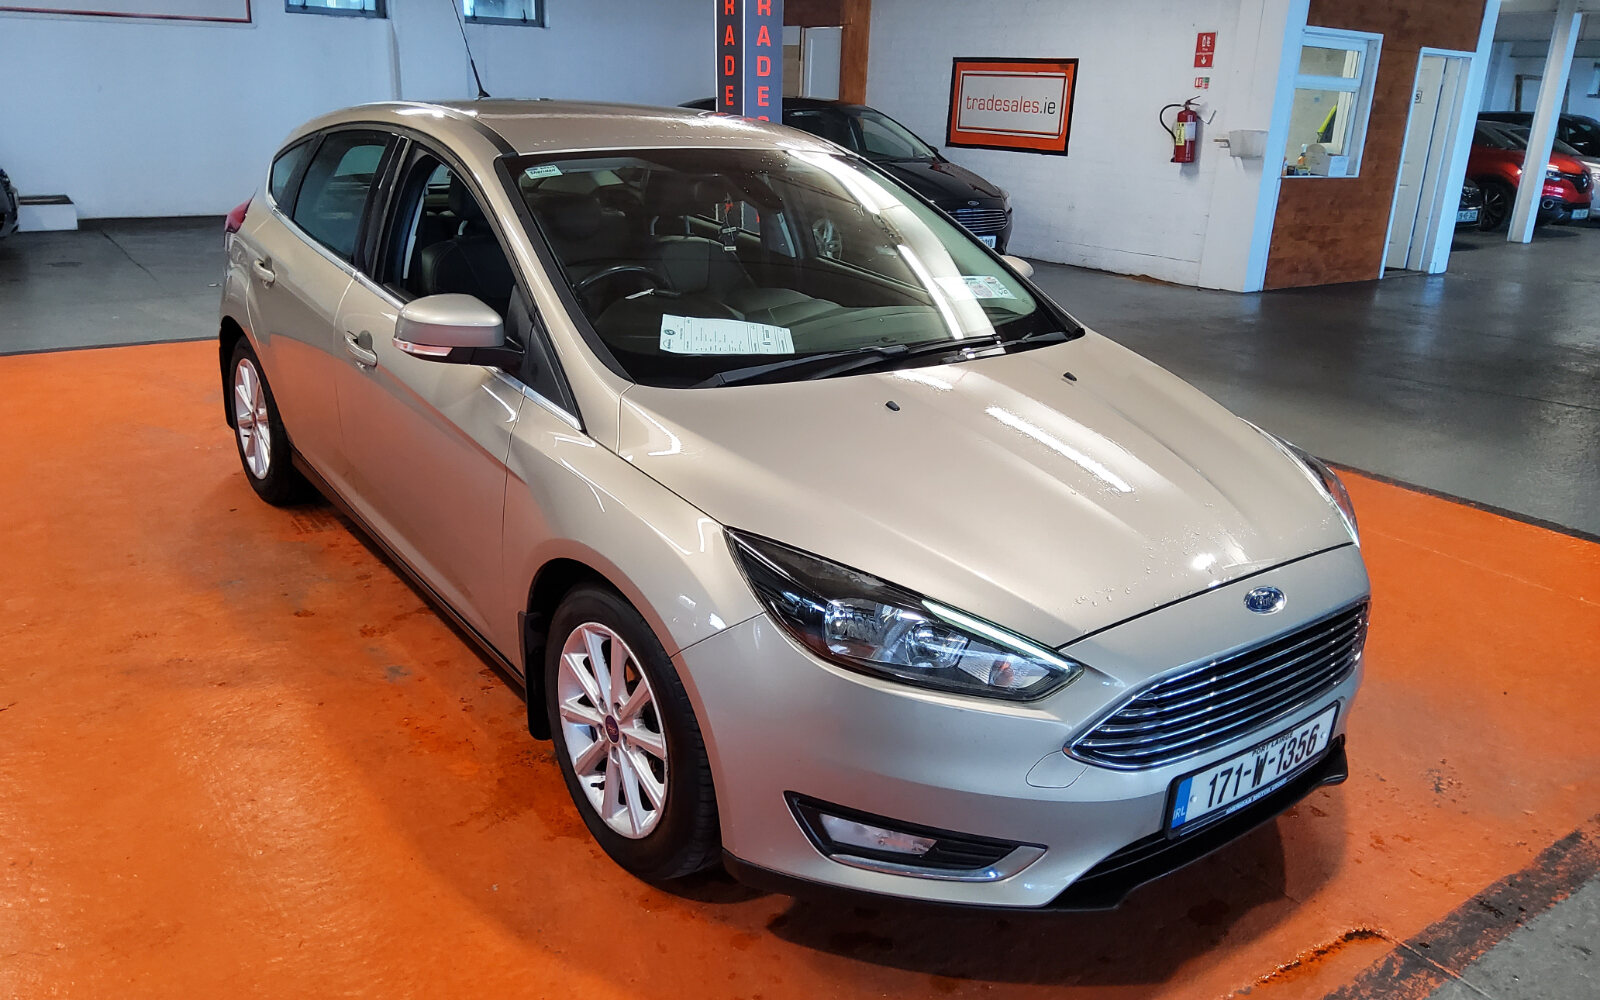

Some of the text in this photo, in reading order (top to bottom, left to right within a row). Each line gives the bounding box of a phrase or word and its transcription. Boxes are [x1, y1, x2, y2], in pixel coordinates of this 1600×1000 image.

[966, 94, 1056, 115] tradesales.ie
[1208, 723, 1320, 808] 171-W-1356
[1173, 806, 1186, 820] IRL
